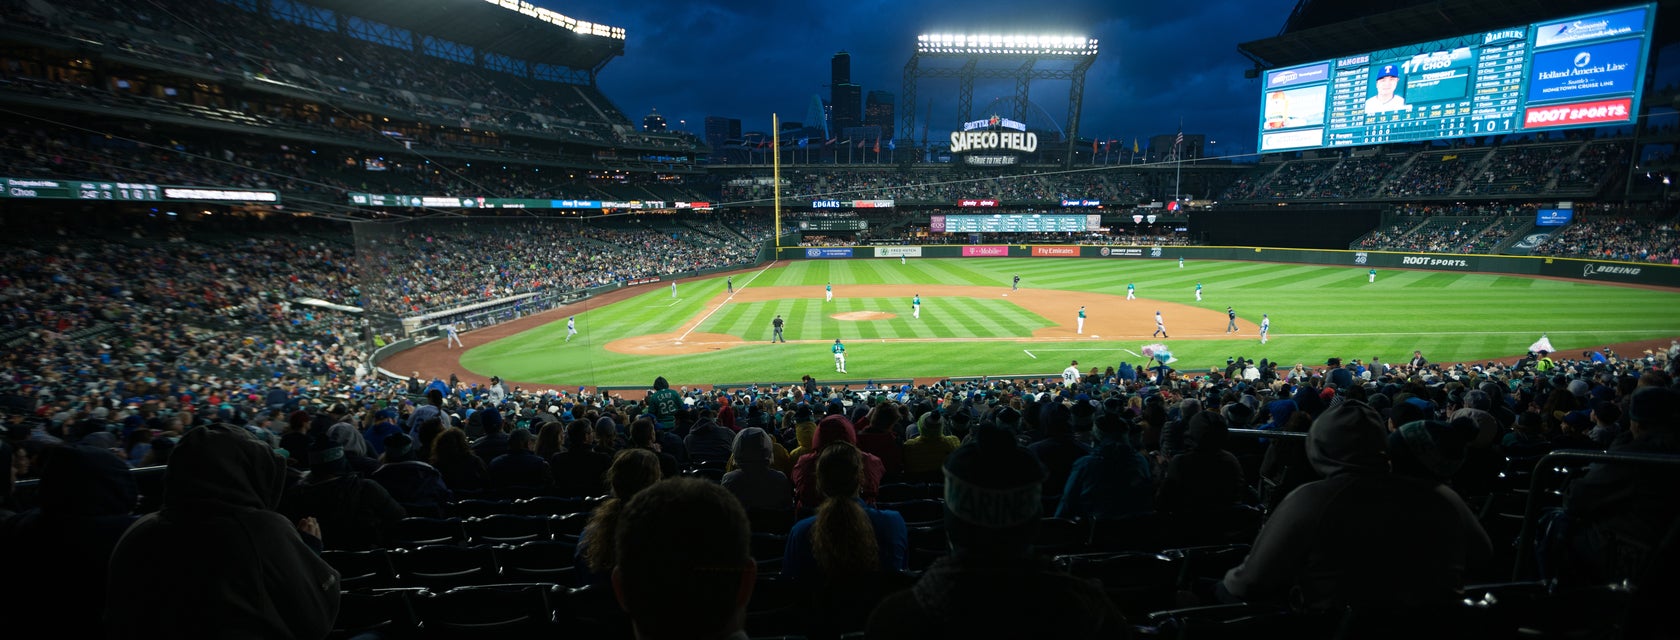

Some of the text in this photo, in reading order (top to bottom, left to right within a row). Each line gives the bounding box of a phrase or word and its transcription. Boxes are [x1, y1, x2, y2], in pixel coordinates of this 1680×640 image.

[1338, 56, 1369, 67] RANGERS
[1401, 61, 1422, 74] 17
[1423, 60, 1451, 71] CHOO
[1539, 63, 1625, 80] Holland America Line
[1543, 85, 1577, 93] HOMETOWN
[1527, 108, 1570, 123] ROOT
[964, 120, 989, 131] SEATTLE
[1473, 119, 1510, 133] 1 0 1
[951, 131, 1038, 153] SAFECO FIELD
[1403, 256, 1430, 265] ROOT
[1597, 266, 1641, 275] BOEING
[660, 400, 676, 415] 22
